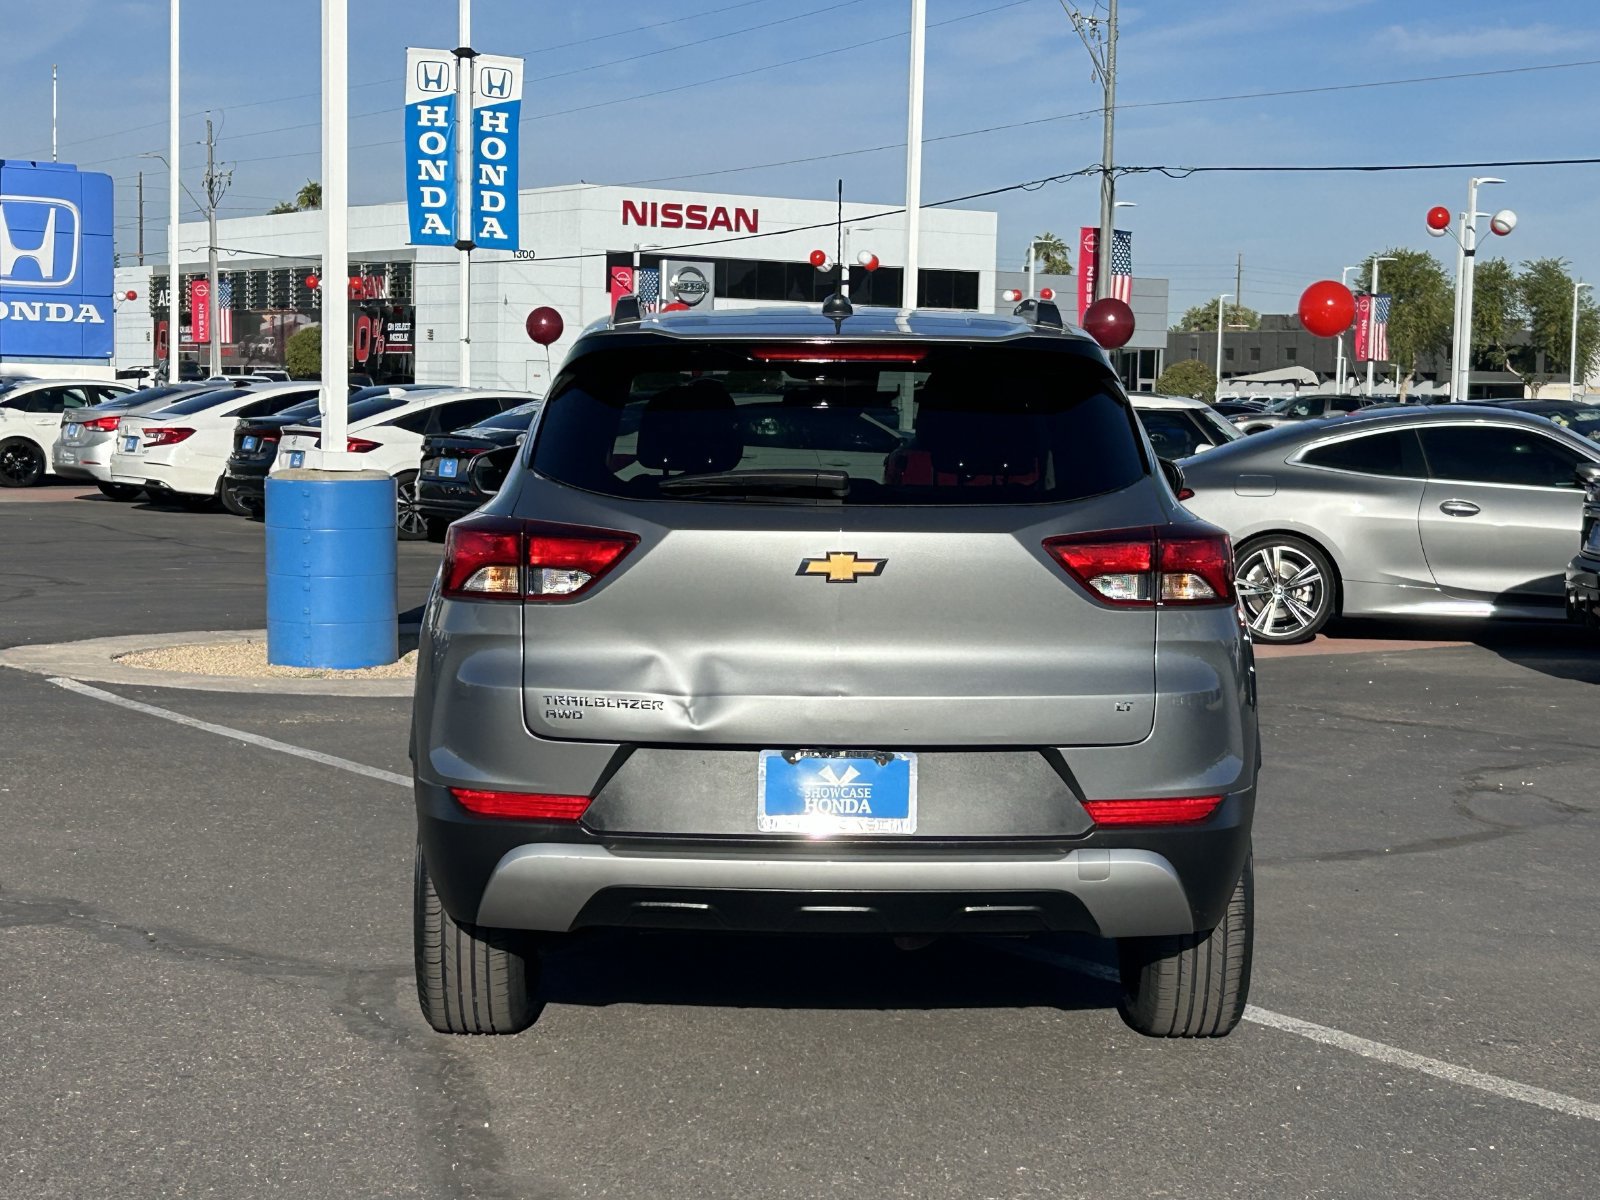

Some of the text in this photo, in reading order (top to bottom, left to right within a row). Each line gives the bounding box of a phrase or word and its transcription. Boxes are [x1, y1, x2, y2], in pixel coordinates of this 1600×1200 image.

[417, 105, 450, 235] HONDA
[479, 110, 509, 239] HONDA
[622, 200, 758, 233] NISSAN
[513, 249, 535, 259] 1300
[1086, 266, 1094, 308] NISS
[543, 695, 664, 710] TRAILBLAZER
[545, 709, 584, 720] AWD
[804, 787, 872, 799] SHOWCASE
[804, 799, 872, 814] HONDA
